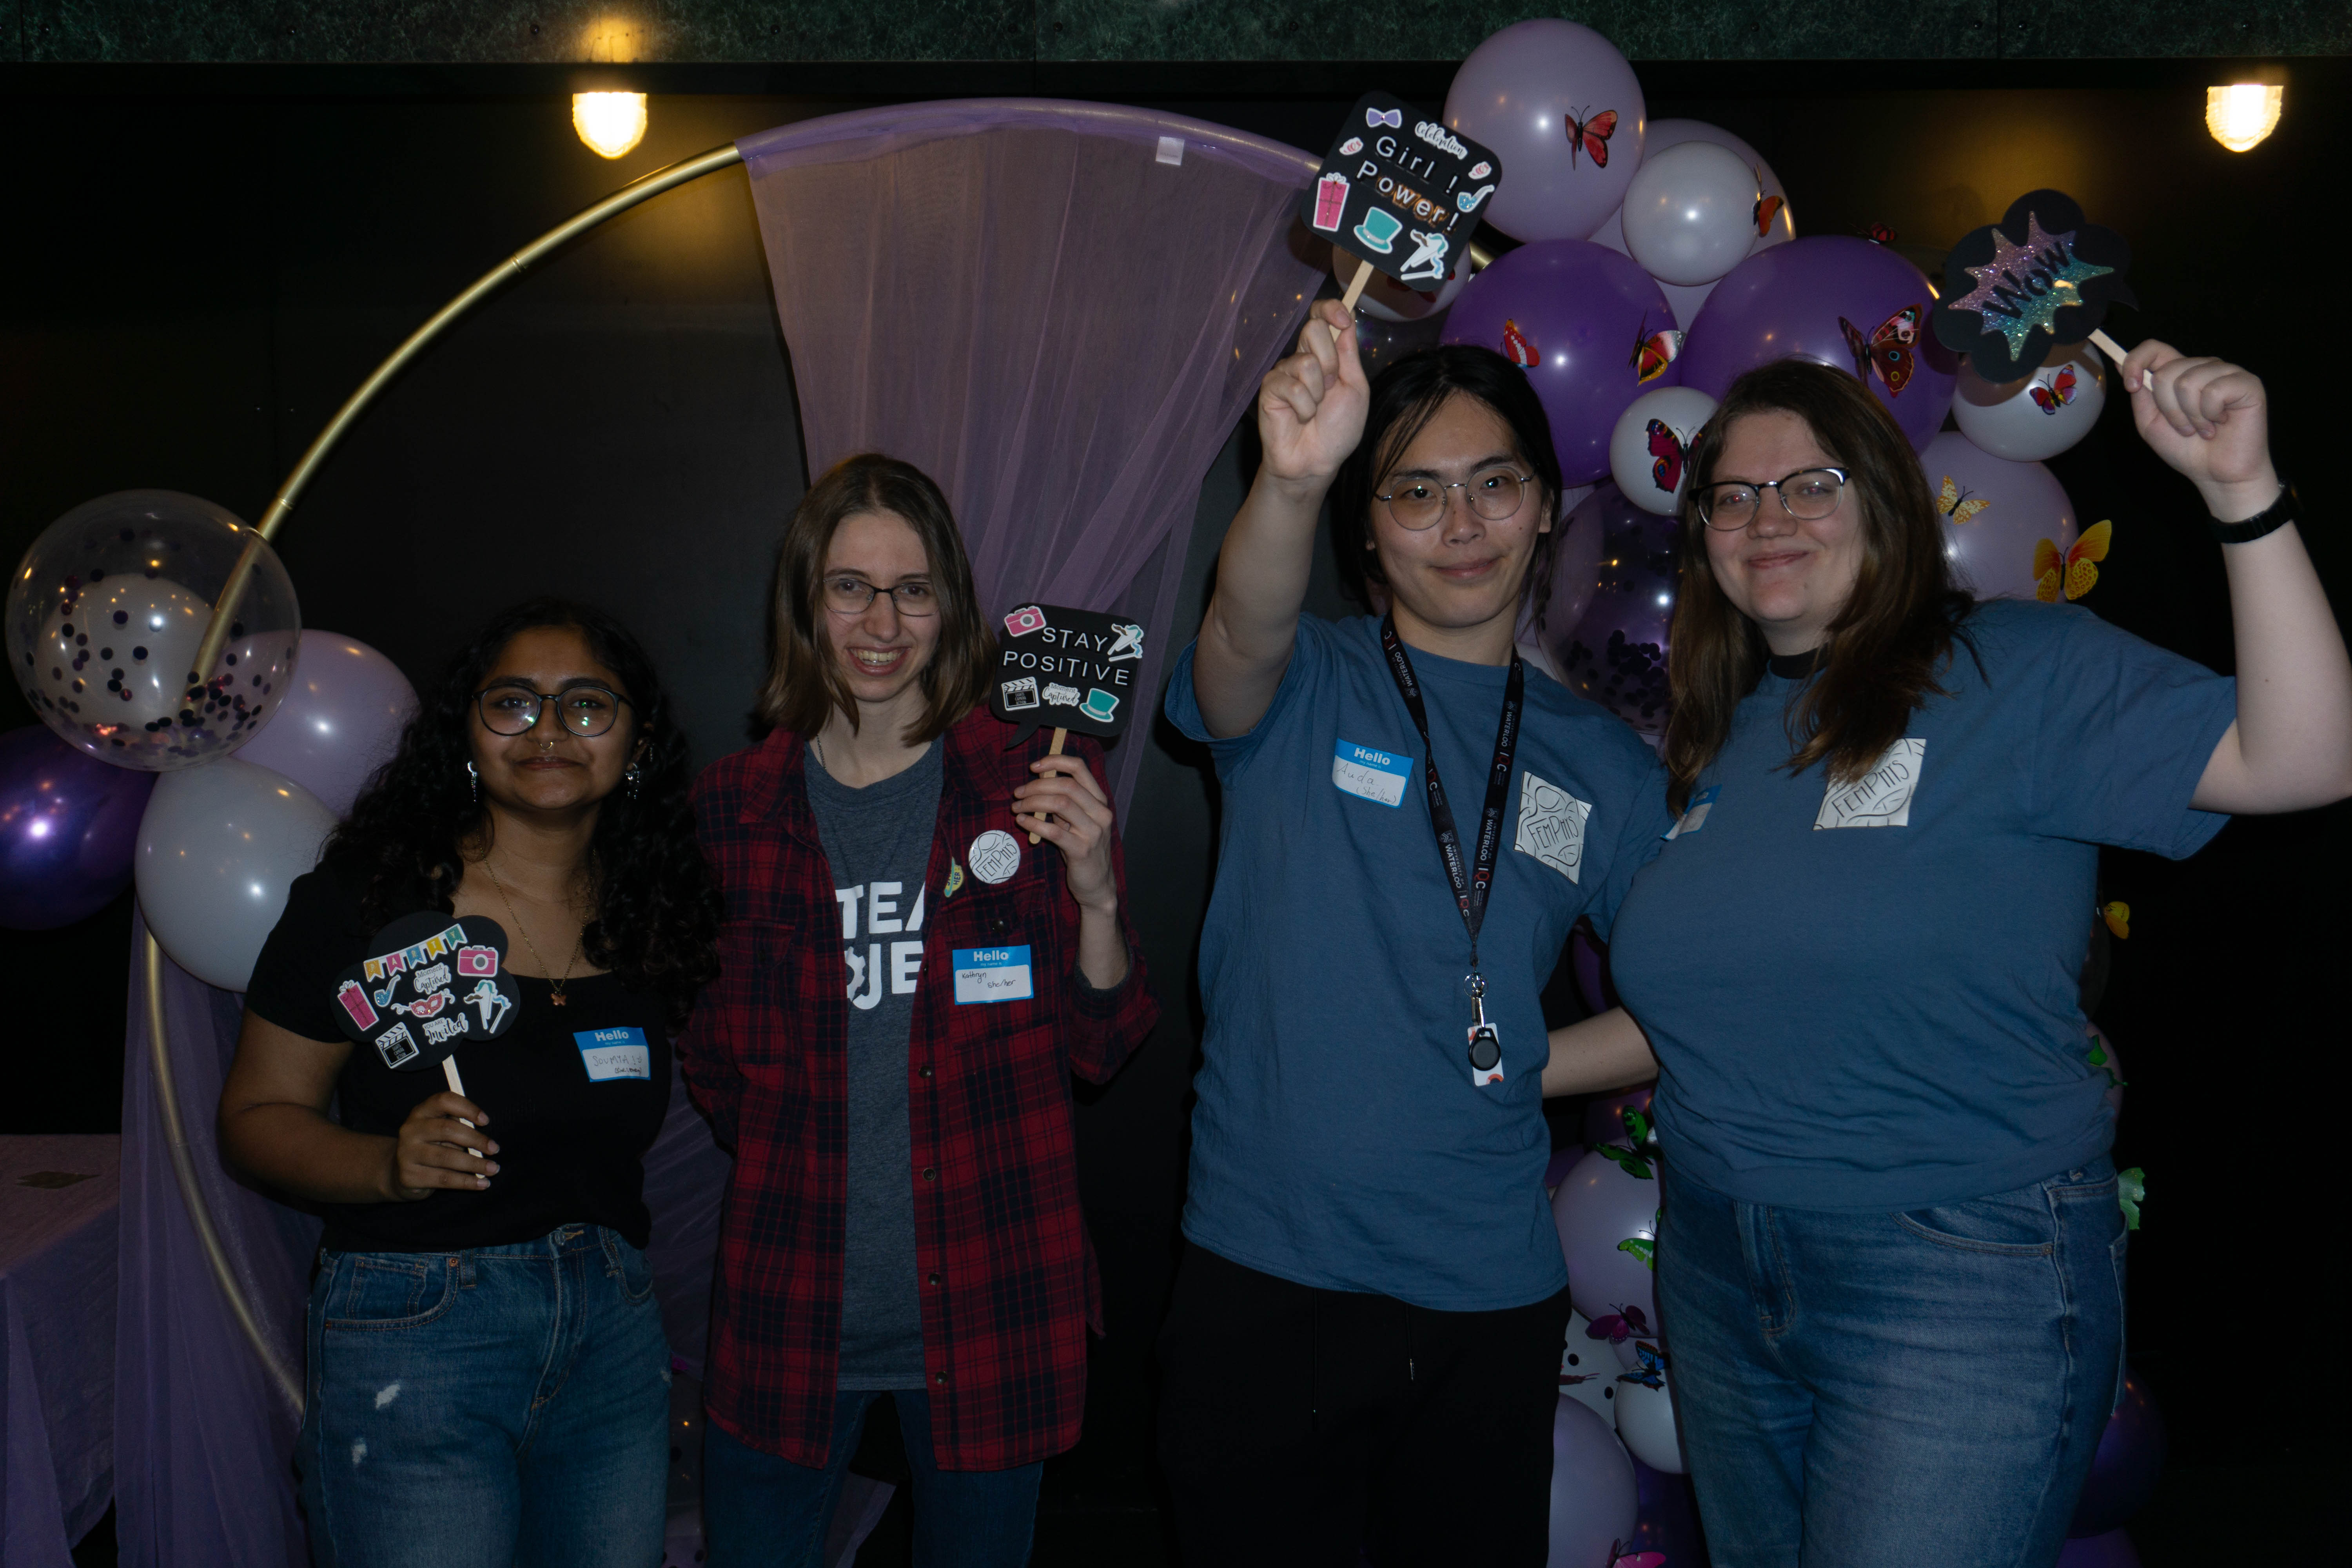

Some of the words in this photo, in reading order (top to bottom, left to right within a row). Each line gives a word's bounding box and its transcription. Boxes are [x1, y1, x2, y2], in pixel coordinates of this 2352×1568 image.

[1416, 122, 1463, 156] Celebration
[1376, 136, 1436, 178] Girl
[1982, 241, 2070, 319] WOW
[1041, 627, 1109, 652] STAY
[1002, 650, 1130, 686] POSITIVE
[1395, 652, 1413, 686] WATERLOO
[1043, 687, 1078, 704] Captured
[1051, 683, 1076, 693] Moment
[1501, 711, 1513, 747] WATERLOO
[1354, 748, 1390, 766] Hello
[1495, 751, 1510, 772] IQC
[1480, 819, 1493, 861] WATERLOO
[1445, 844, 1461, 889] WATERLOO
[1459, 895, 1470, 917] IQC
[1474, 867, 1490, 889] IQC
[368, 930, 456, 972] PARTY
[973, 950, 1009, 962] Hello
[414, 967, 449, 992] Captured
[416, 966, 443, 978] Moment
[427, 1014, 466, 1043] Invited
[594, 1029, 629, 1042] Hello
